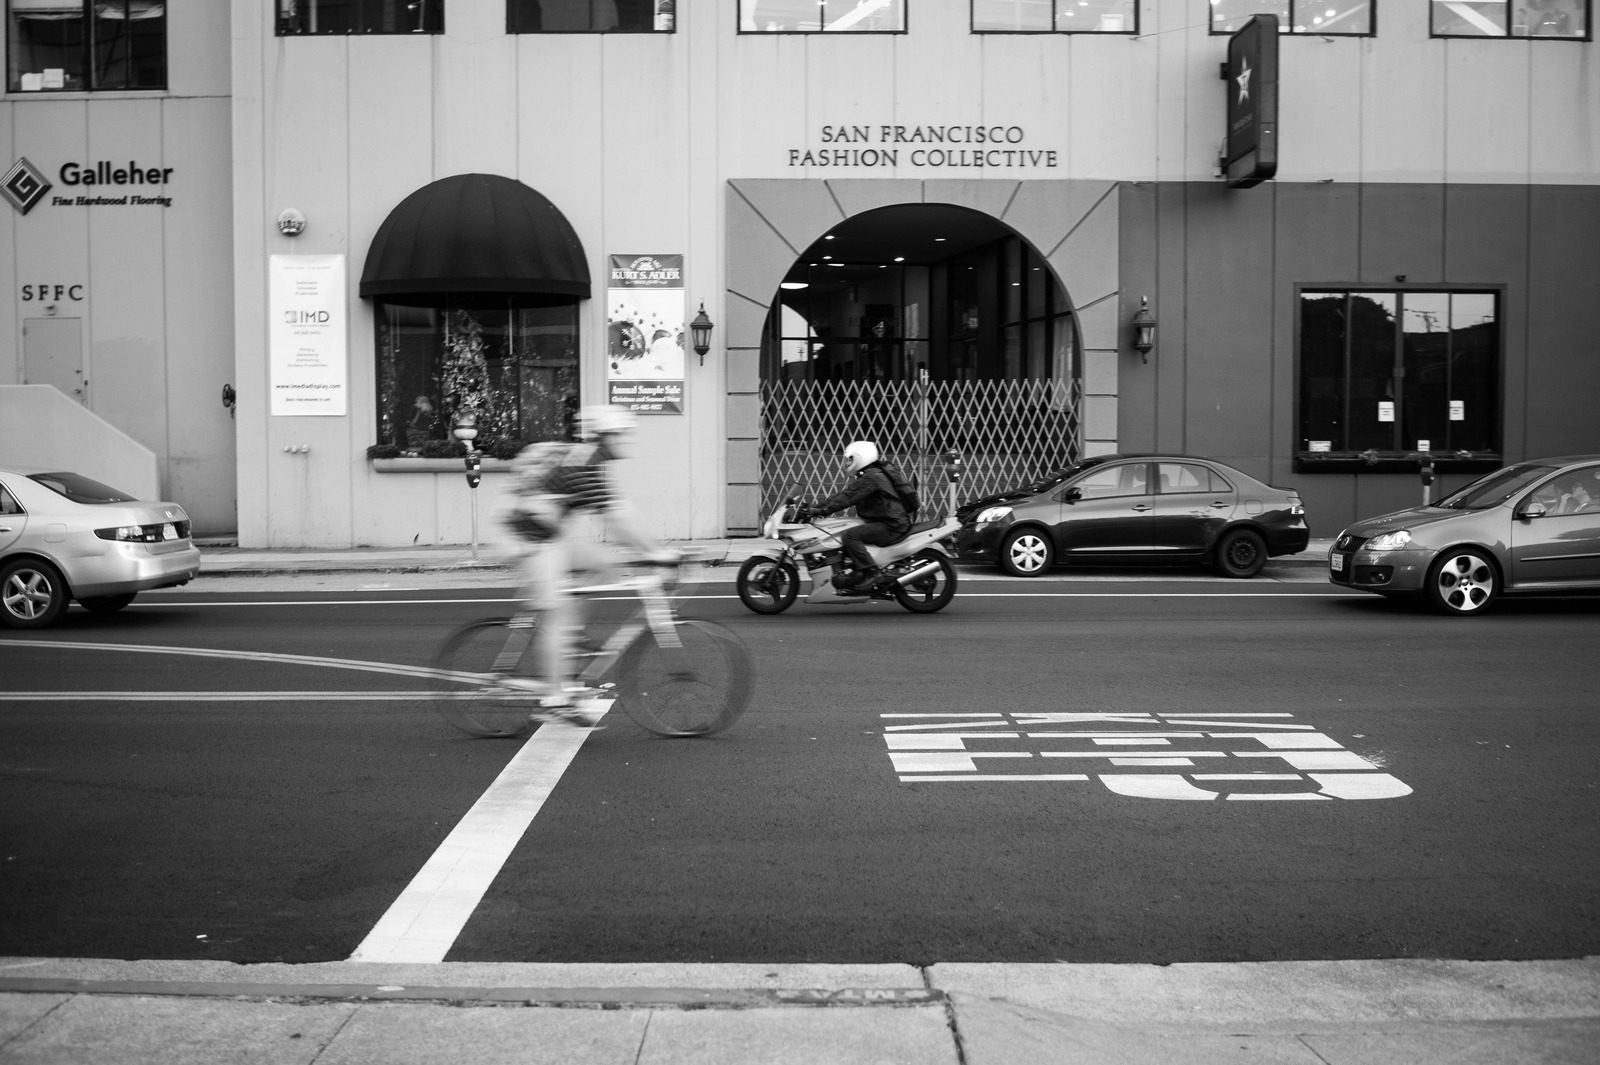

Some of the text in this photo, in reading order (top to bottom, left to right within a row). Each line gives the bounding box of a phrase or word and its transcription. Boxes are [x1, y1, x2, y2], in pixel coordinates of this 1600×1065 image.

[821, 125, 1024, 144] SAN FRANCISCO
[788, 149, 1058, 168] FASHION COLLECTIVE
[60, 161, 173, 186] Galleher
[52, 195, 173, 208] Fine Hardwood Flooring
[611, 271, 639, 280] KURT
[648, 271, 680, 280] ADLER
[22, 284, 84, 302] SFFC
[299, 310, 330, 324] IMD
[611, 385, 681, 396] Annual Sample Sale
[880, 712, 1414, 801] KEEP
